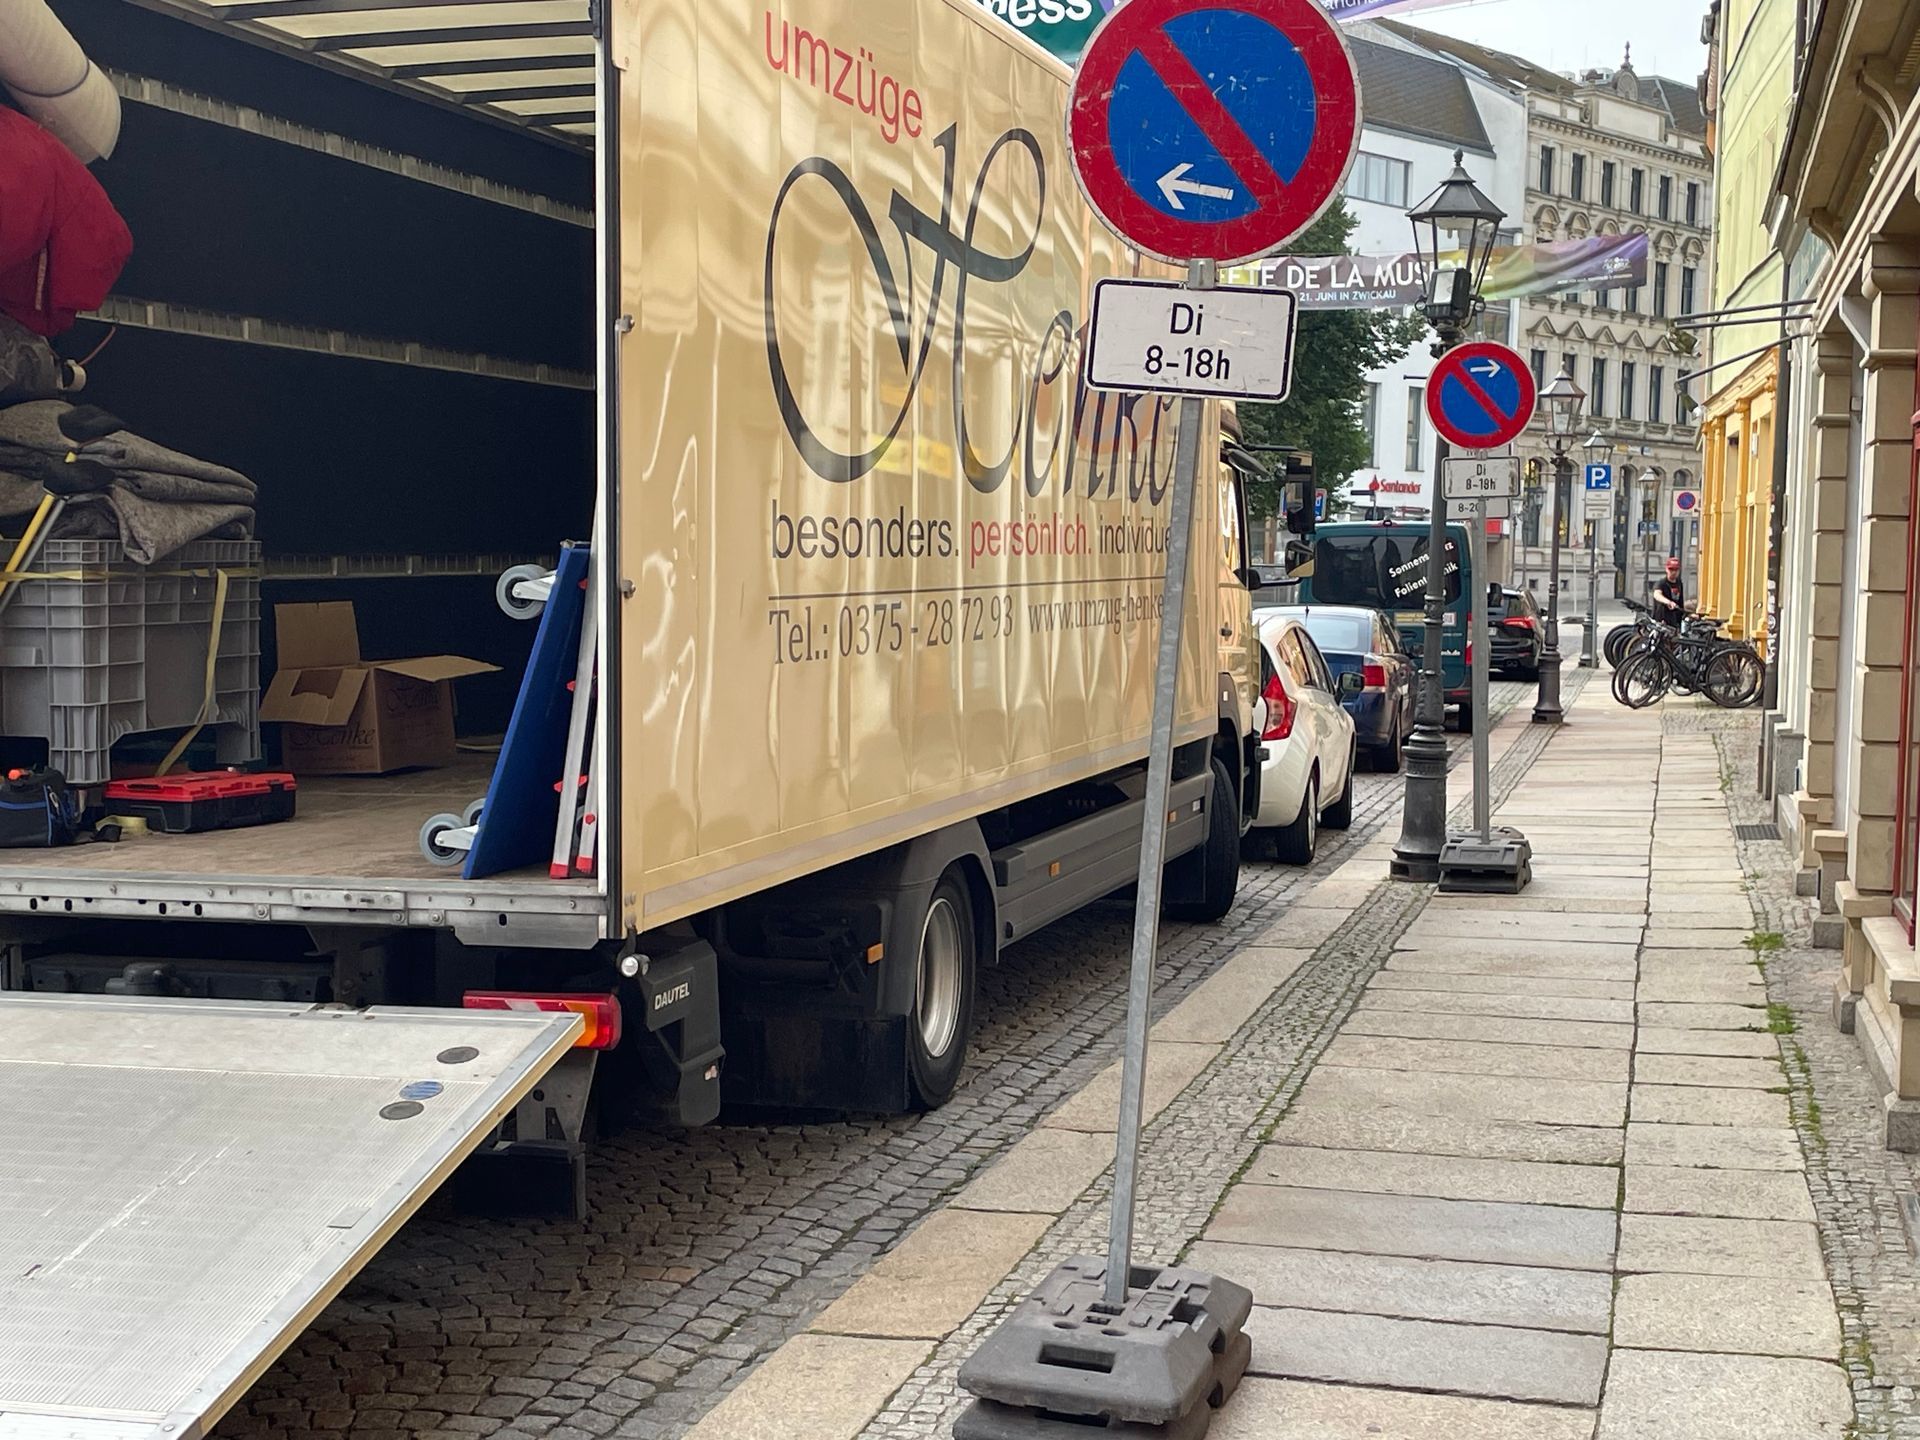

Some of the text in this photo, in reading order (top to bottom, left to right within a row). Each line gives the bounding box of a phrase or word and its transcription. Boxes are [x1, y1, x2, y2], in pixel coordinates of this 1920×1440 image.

[766, 11, 922, 144] umzüge
[1287, 265, 1320, 289] DE
[1331, 263, 1364, 289] LA
[1299, 290, 1396, 301] 21. JUNI IN ZWICKAU
[1170, 303, 1203, 335] Di
[1145, 345, 1230, 379] 8-18h
[1465, 478, 1496, 490] 8-18h
[1476, 464, 1487, 476] Di
[1380, 479, 1422, 494] Santander
[772, 499, 959, 558] besonders.
[971, 512, 1092, 569] persönlich.
[769, 606, 828, 665] Tel.:
[839, 601, 902, 657] 0375
[654, 982, 690, 1010] DAUTEL
